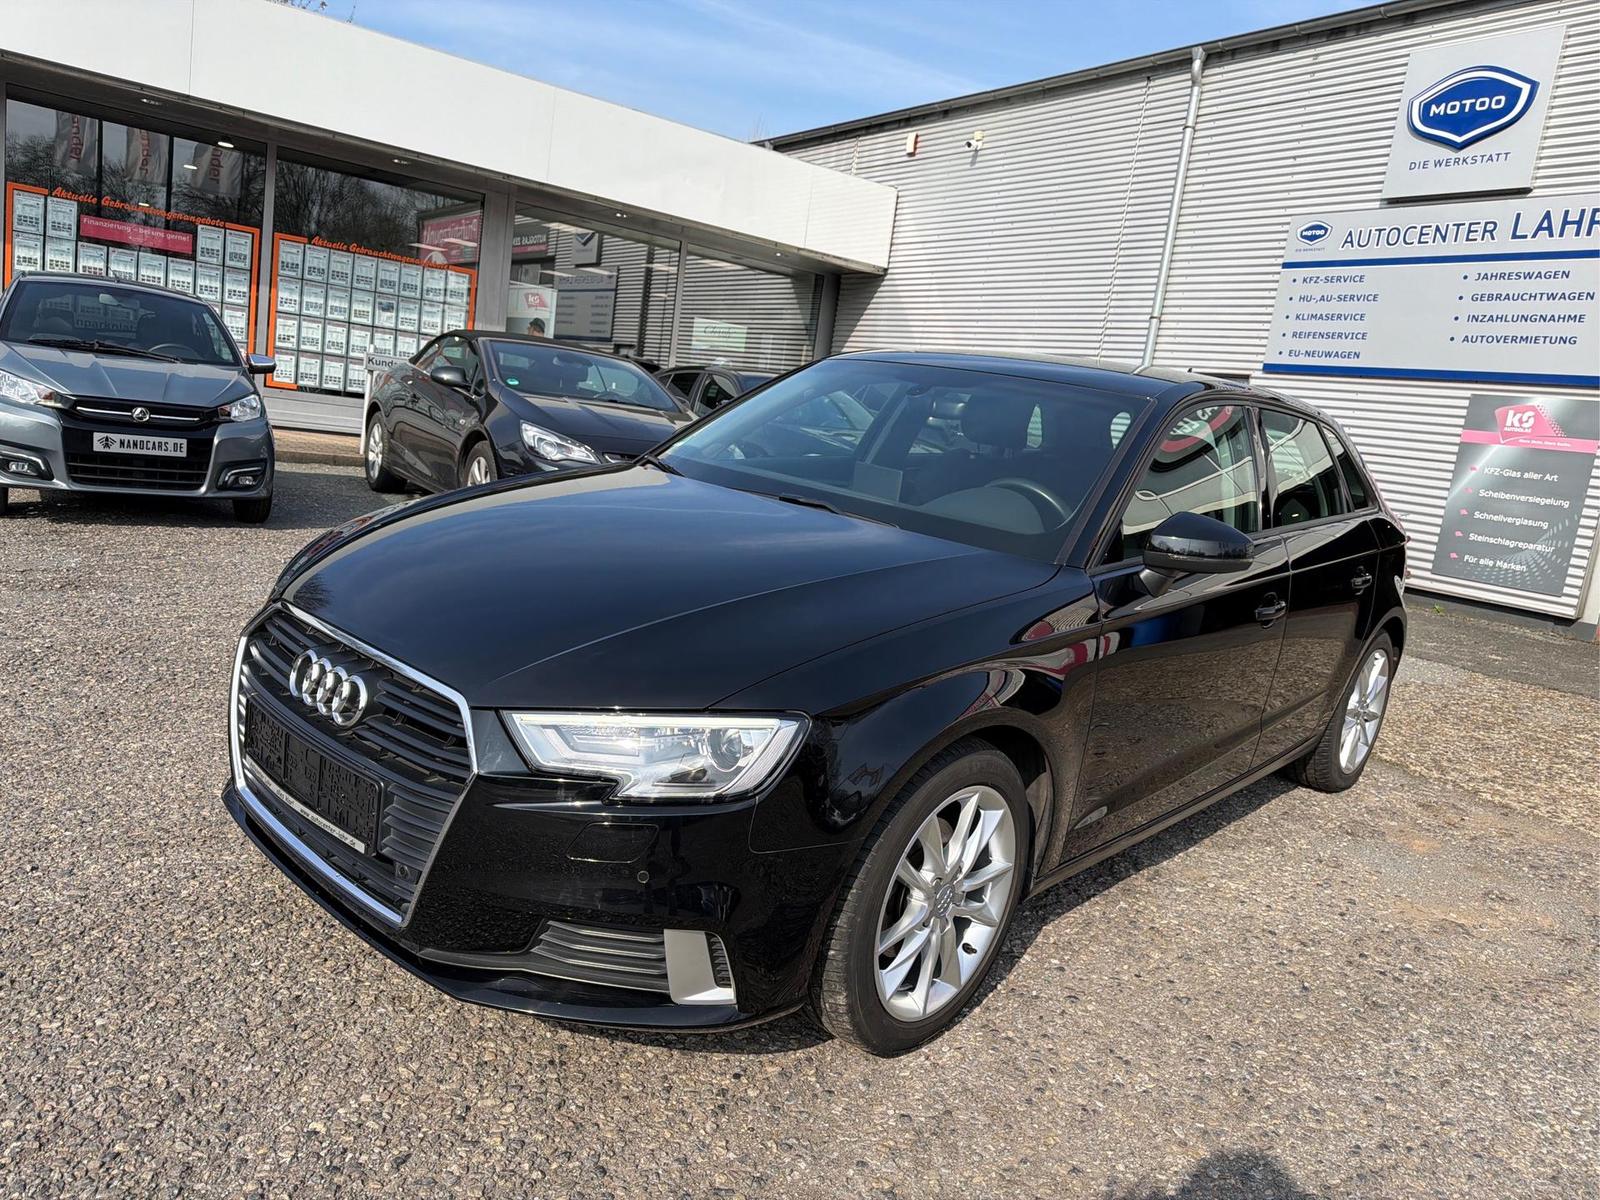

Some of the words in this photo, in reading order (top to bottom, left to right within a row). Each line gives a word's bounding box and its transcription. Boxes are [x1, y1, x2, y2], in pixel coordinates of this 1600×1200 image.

[1429, 95, 1506, 117] MOTOO
[1409, 160, 1430, 171] DIE
[1433, 152, 1512, 169] WERKSTATT
[51, 186, 98, 205] Aktuelle
[83, 217, 132, 234] Finanzierung
[151, 230, 165, 239] uns
[166, 232, 190, 243] gerne!
[1340, 220, 1499, 250] AUTOCENTER
[311, 236, 348, 251] Aktuelle
[1302, 274, 1365, 284] KFZ-SERVICE
[1474, 270, 1571, 281] JAHRESWAGEN
[1298, 294, 1379, 303] HU-,AU-SERVICE
[1470, 291, 1595, 302] GEBRAUCHTWAGEN
[1295, 313, 1366, 322] KLIMASERVICE
[1466, 313, 1587, 323] INZAHLUNGNAHME
[1291, 331, 1368, 341] REIFENSERVICE
[1461, 335, 1578, 345] AUTOVERMIETUNG
[367, 357, 397, 368] Kund
[1288, 350, 1361, 360] EU-NEUWAGEN
[119, 438, 184, 453] NANOCARS.DE
[1483, 467, 1521, 478] KFZ-Glas
[1523, 471, 1541, 480] aller
[1544, 473, 1559, 482] Art
[1478, 489, 1570, 509] Scheibenversiegelung
[1473, 511, 1549, 529] Schnellverglasung
[1468, 532, 1555, 553] Steinschlagreparatur
[1463, 554, 1478, 562] Für
[1479, 556, 1494, 566] alle
[1495, 559, 1527, 572] Marken
